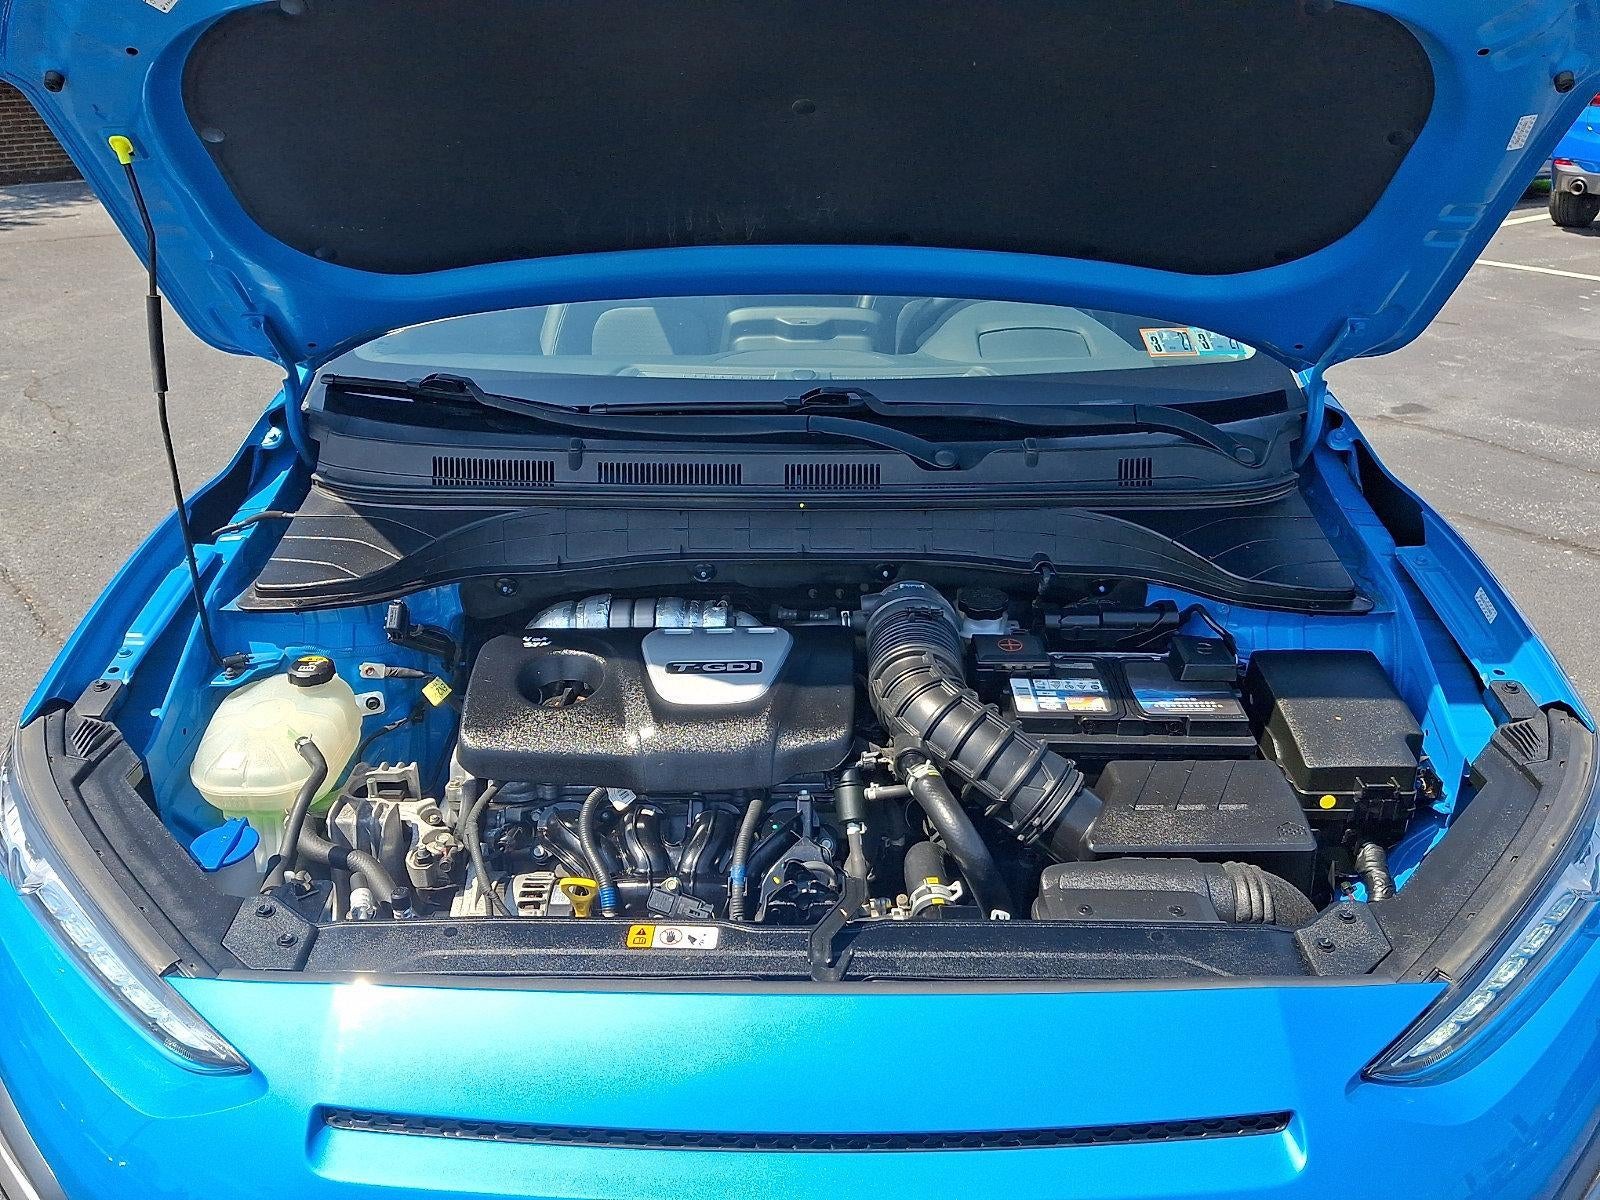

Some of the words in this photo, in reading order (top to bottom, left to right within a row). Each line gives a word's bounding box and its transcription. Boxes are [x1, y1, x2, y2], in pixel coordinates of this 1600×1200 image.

[1150, 336, 1163, 352] 3
[1197, 333, 1211, 350] 3
[672, 662, 758, 673] T-GDI
